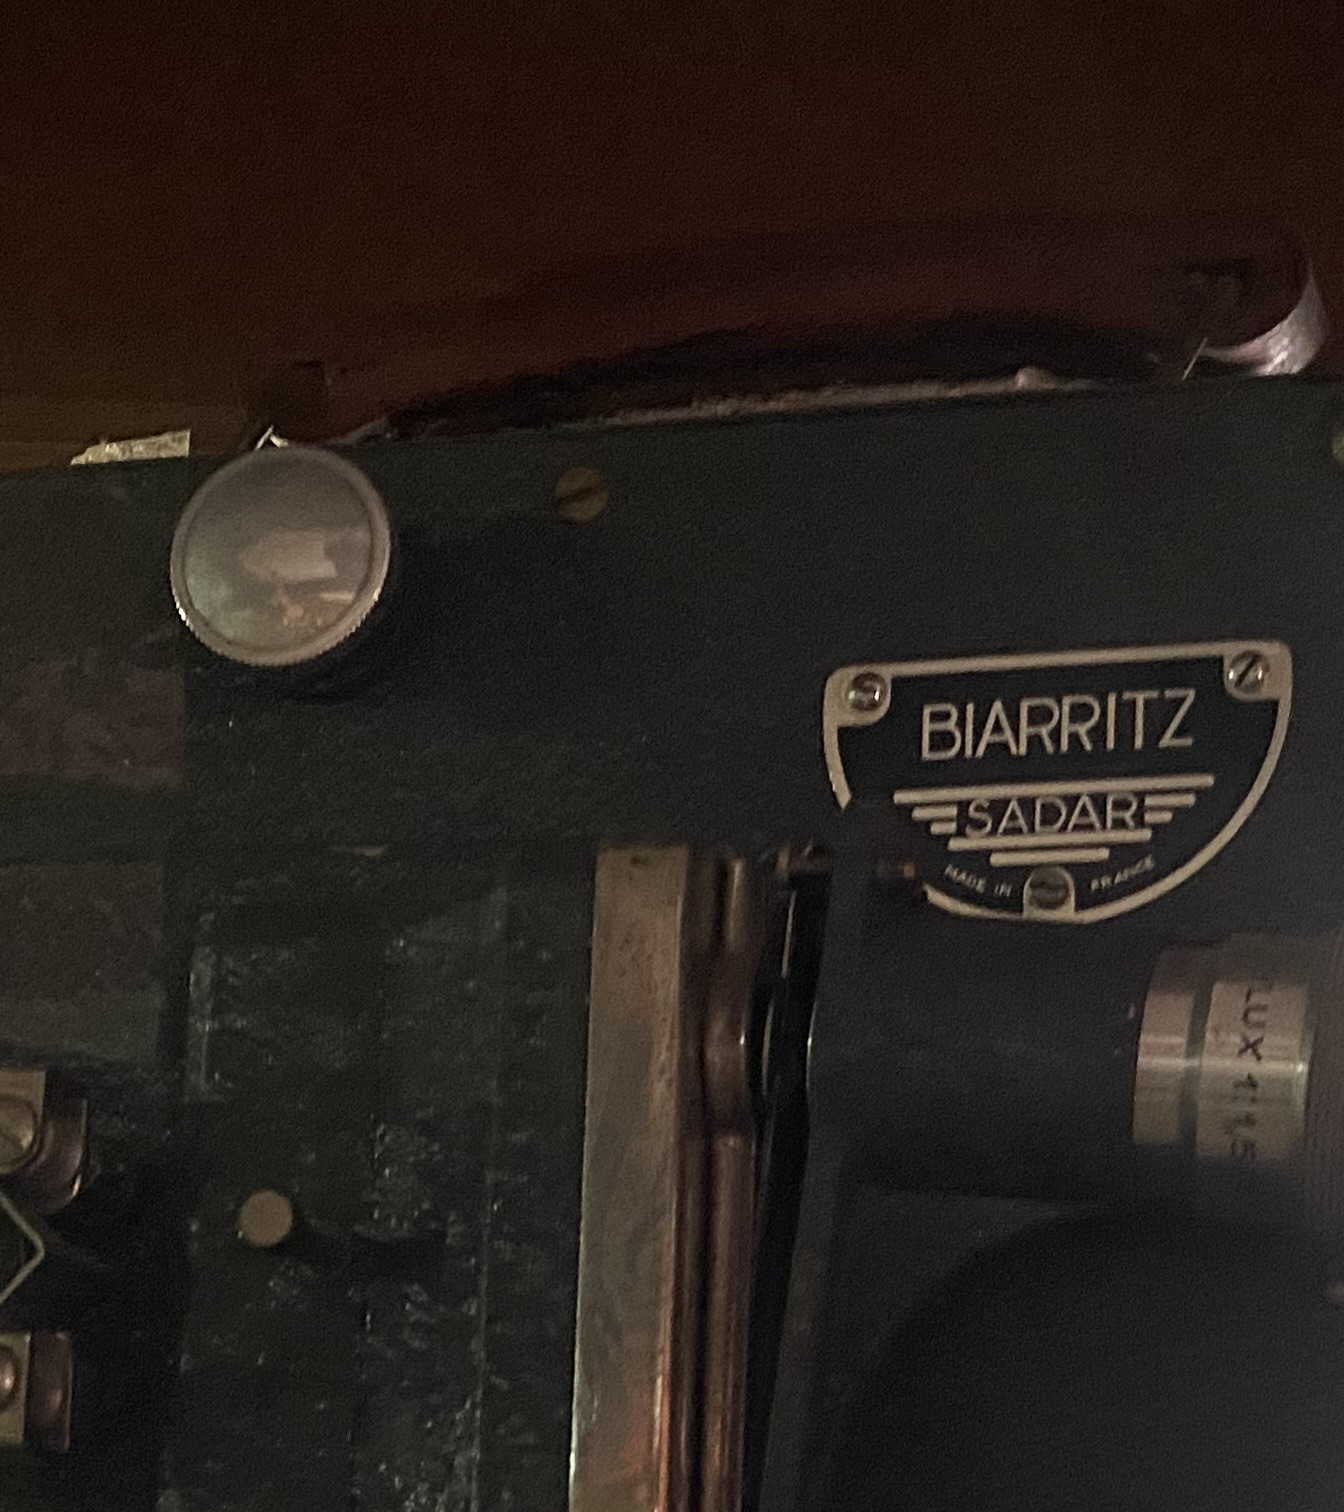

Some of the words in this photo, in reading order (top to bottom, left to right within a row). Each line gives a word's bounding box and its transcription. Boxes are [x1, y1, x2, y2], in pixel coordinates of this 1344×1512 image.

[921, 687, 1197, 761] BIARRITZ
[964, 793, 1139, 838] SADAR
[944, 863, 987, 894] MADE
[993, 881, 1013, 897] IN
[1089, 853, 1155, 892] FRANCE
